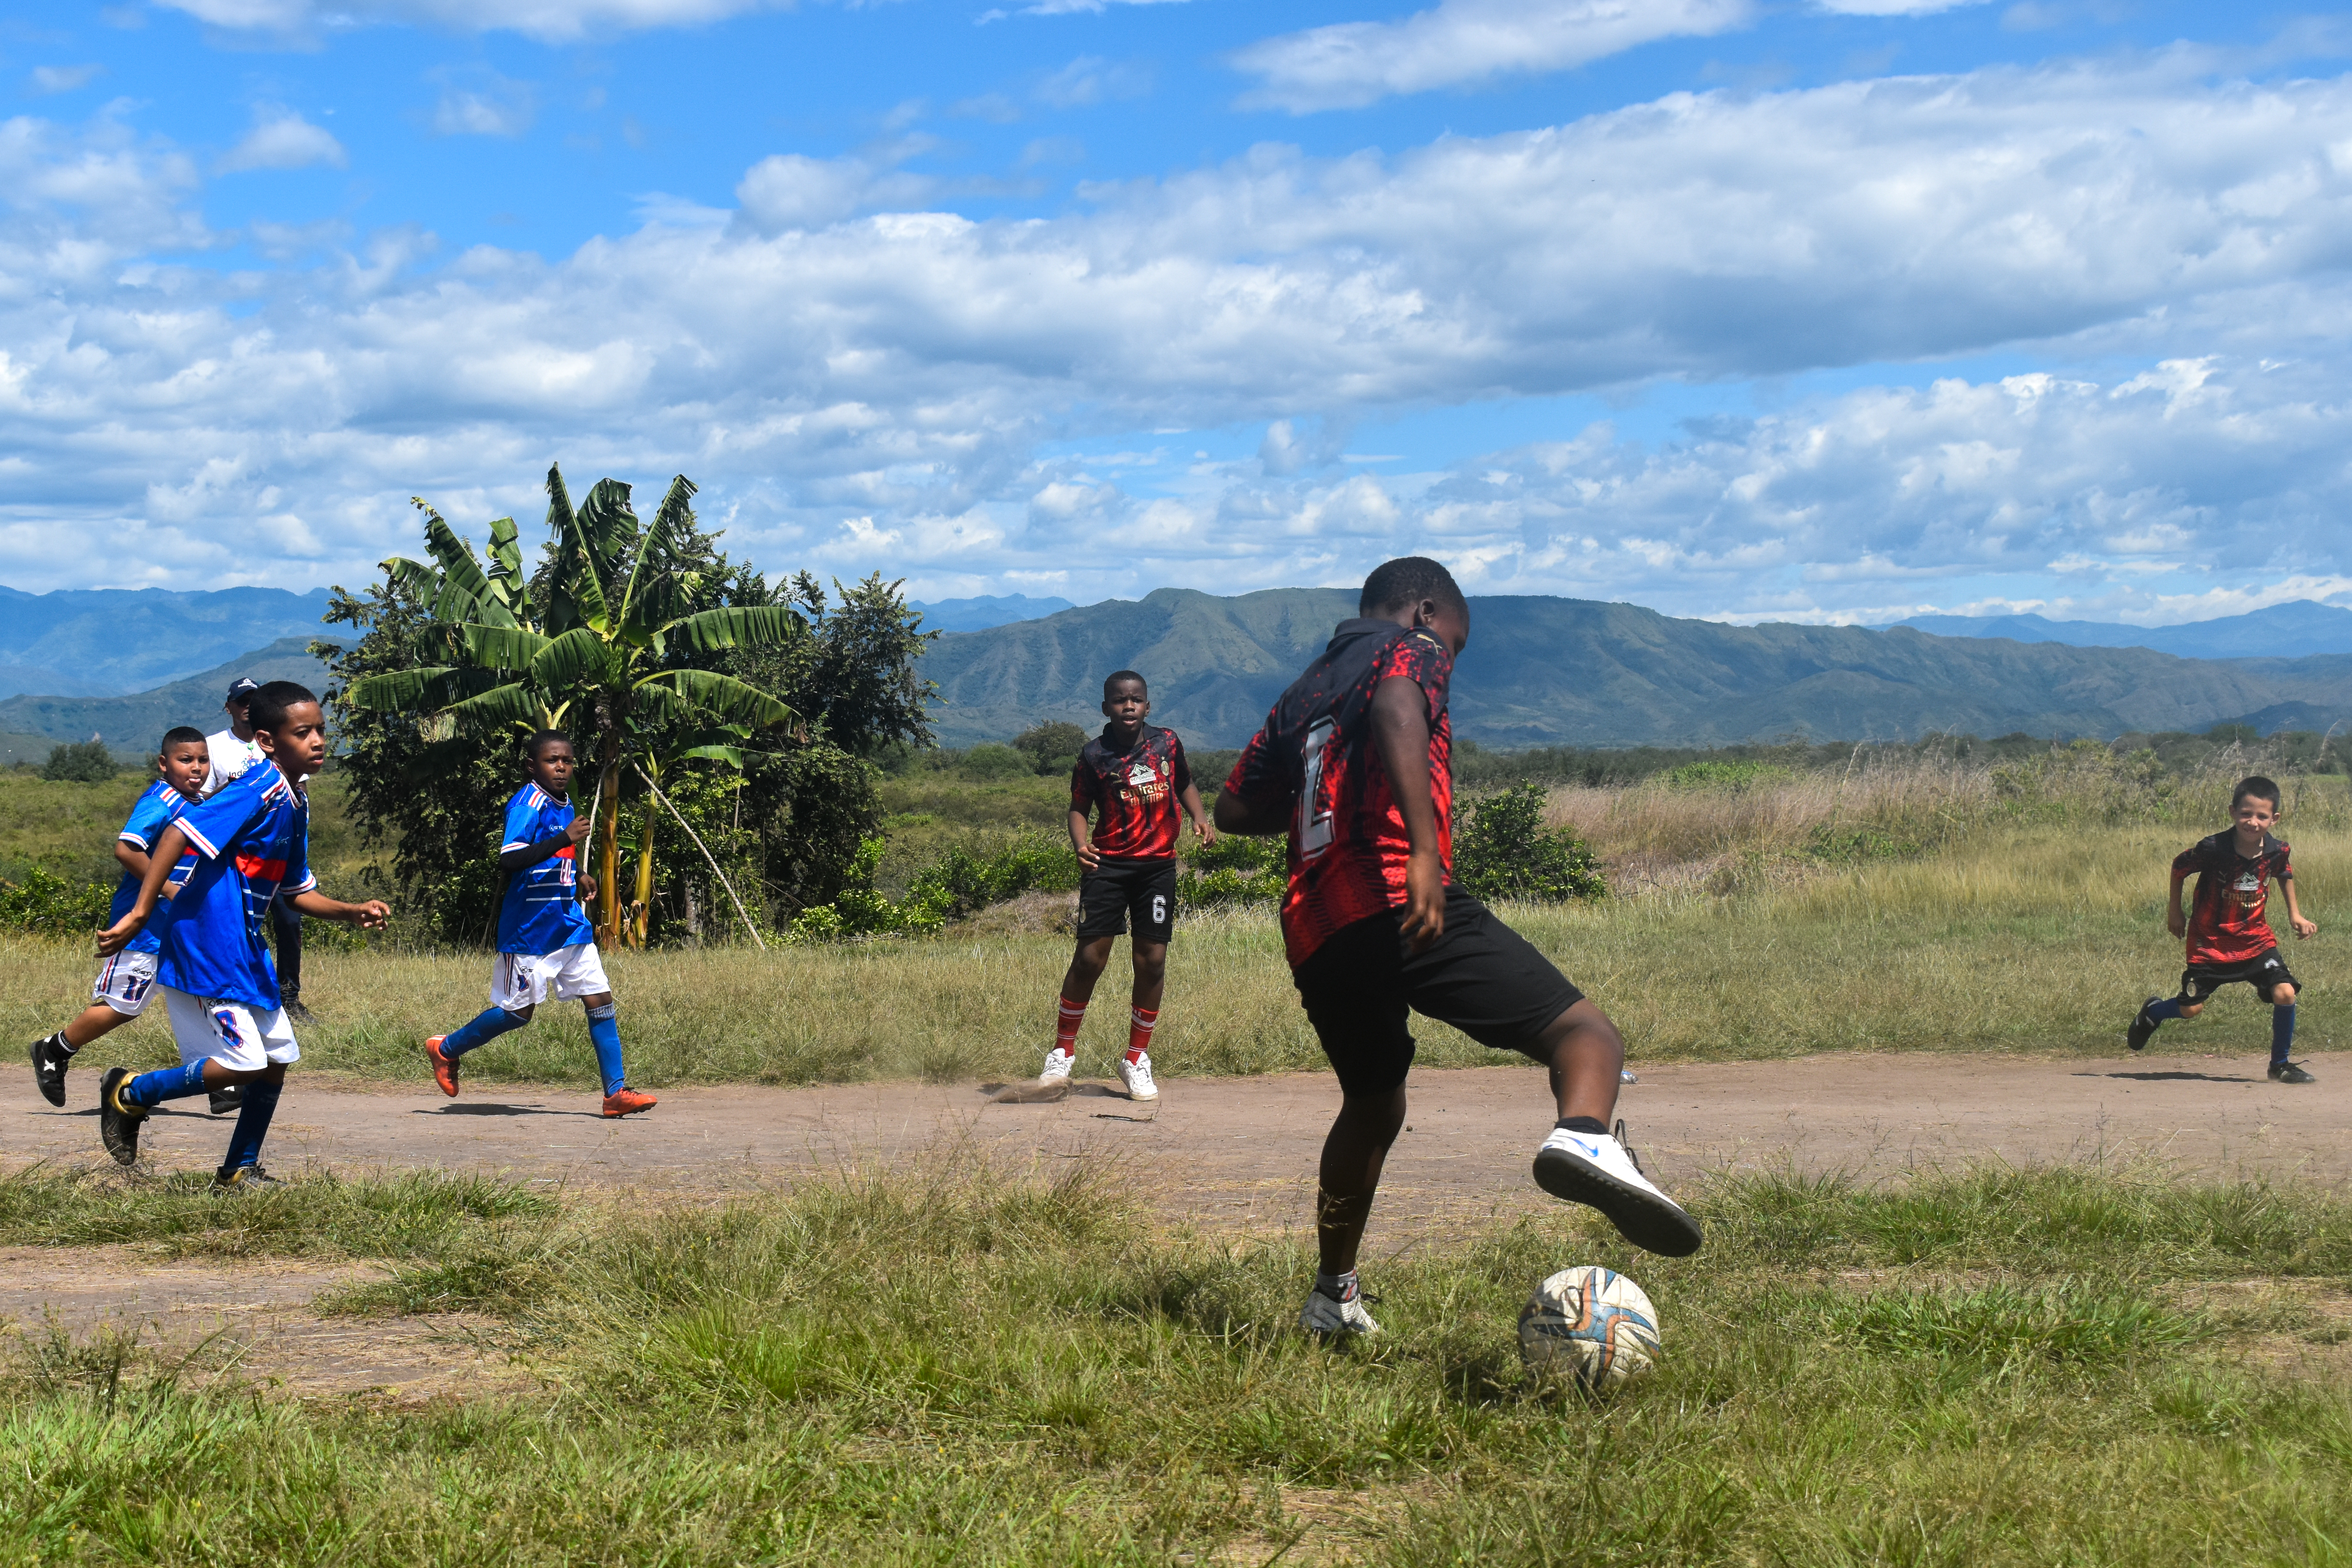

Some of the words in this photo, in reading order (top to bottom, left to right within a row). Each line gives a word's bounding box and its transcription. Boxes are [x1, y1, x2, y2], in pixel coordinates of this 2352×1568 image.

[1120, 782, 1169, 799] Emirates
[1153, 895, 1166, 924] 6
[215, 1009, 244, 1049] 8
